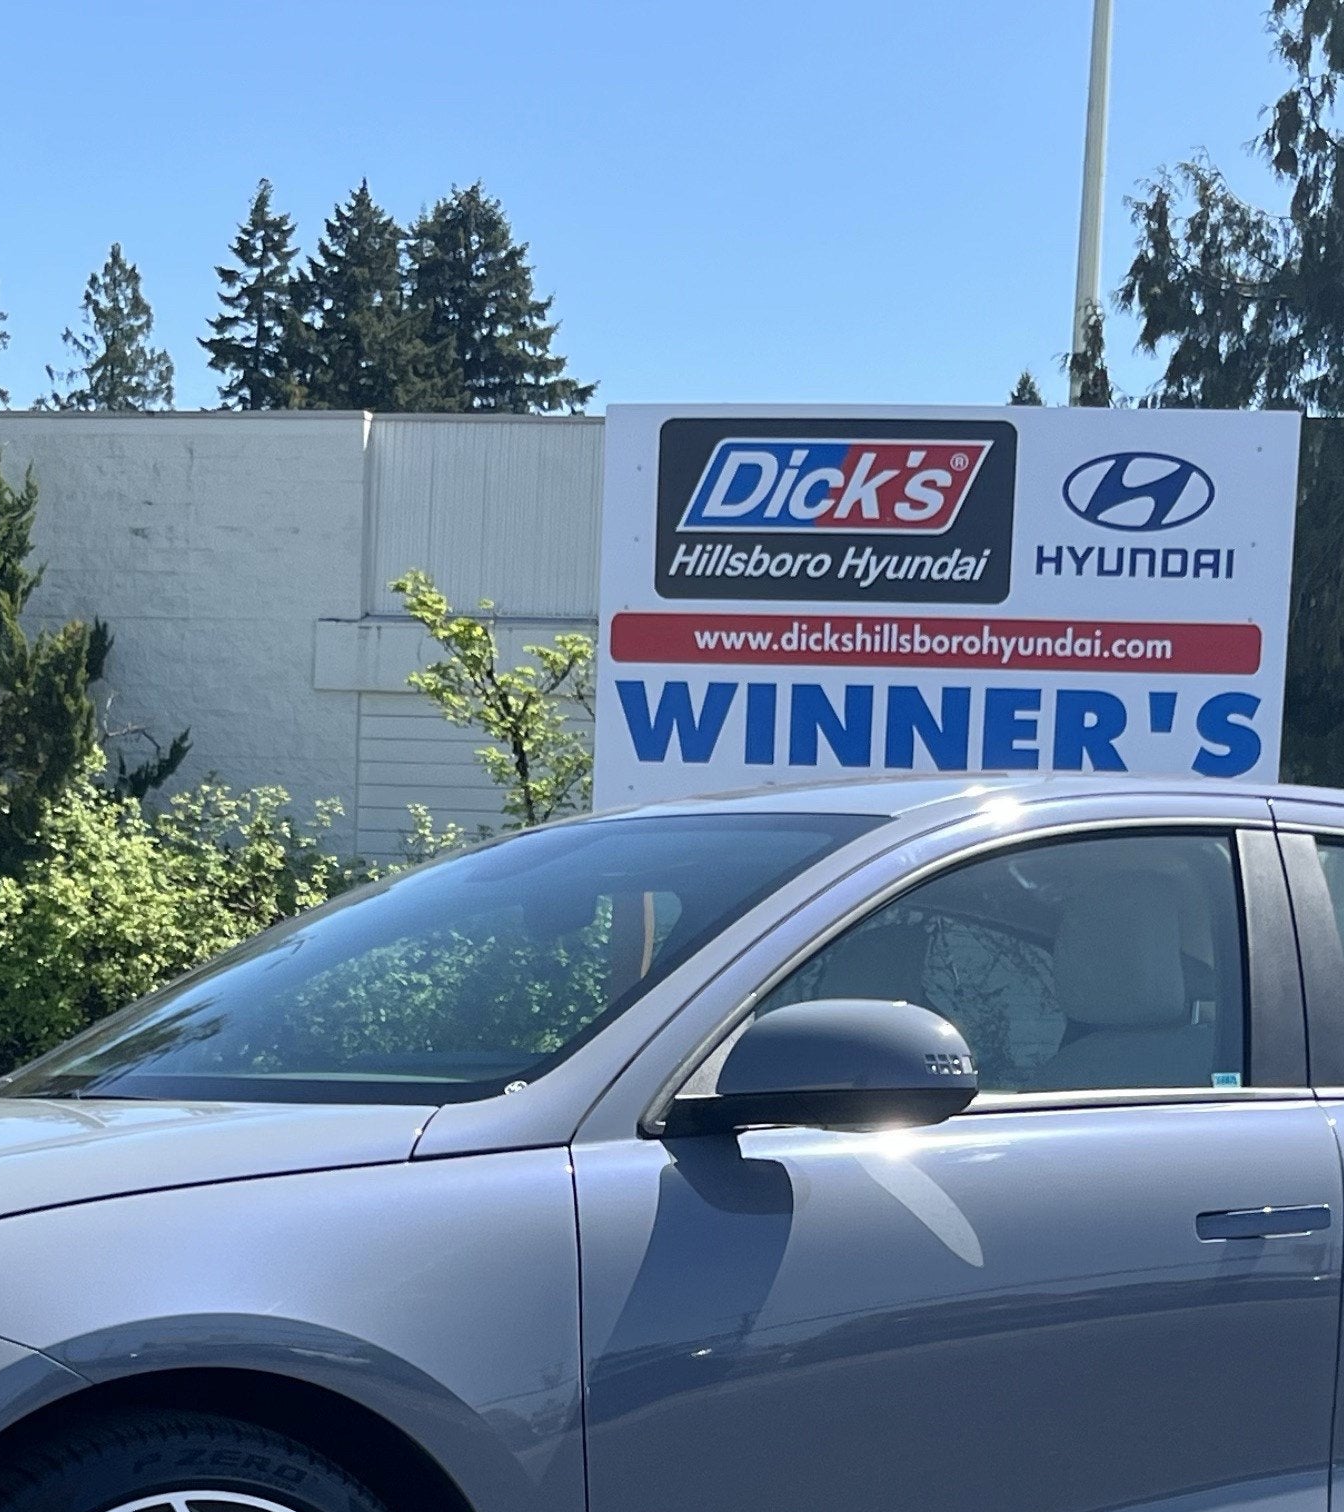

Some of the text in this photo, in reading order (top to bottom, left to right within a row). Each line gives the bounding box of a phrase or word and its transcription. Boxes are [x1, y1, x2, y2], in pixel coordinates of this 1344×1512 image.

[701, 449, 953, 522] Dick's
[668, 543, 992, 588] Hillsboro Hyundai
[1036, 546, 1235, 579] HYUNDAI
[694, 624, 1173, 663] www.dickshillsborohyundai.com
[615, 680, 1263, 778] WINNER'S
